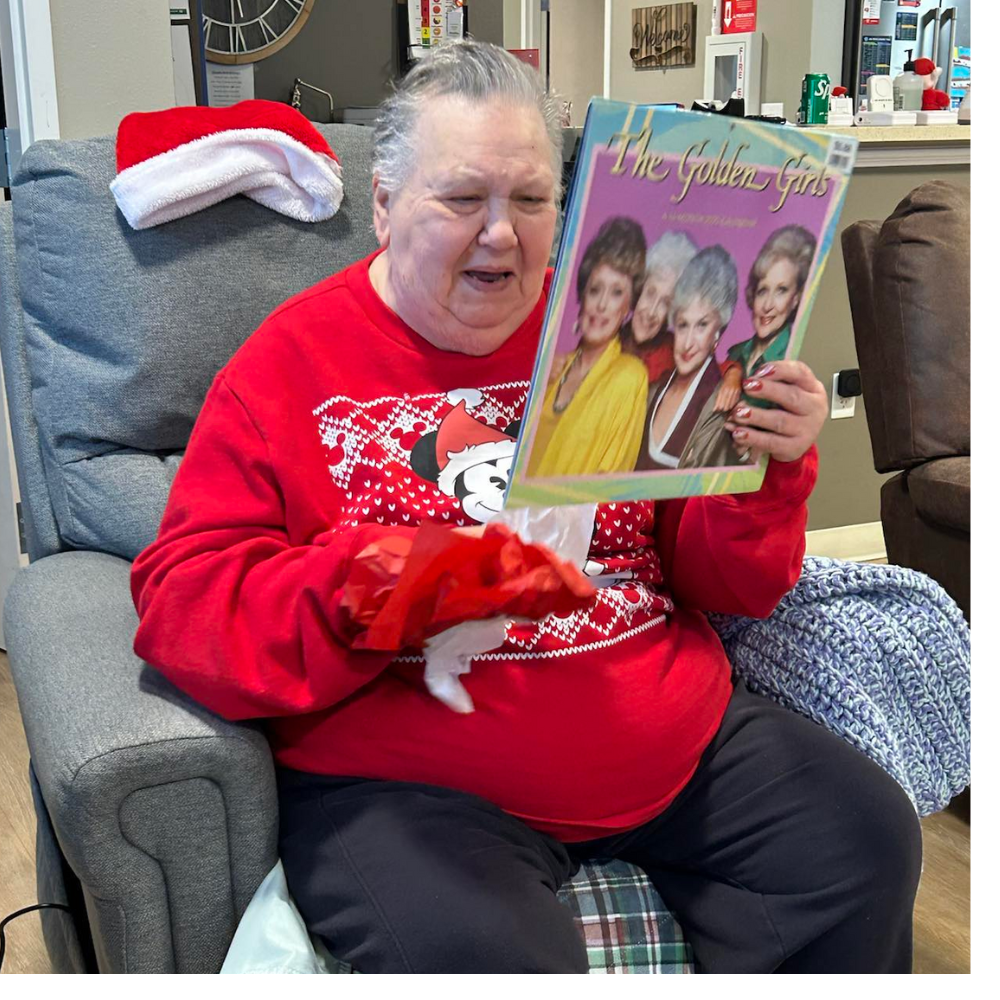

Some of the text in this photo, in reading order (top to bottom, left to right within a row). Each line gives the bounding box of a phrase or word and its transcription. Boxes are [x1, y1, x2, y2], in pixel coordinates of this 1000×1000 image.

[632, 8, 690, 48] Welcome
[606, 122, 832, 213] The Golden Girls
